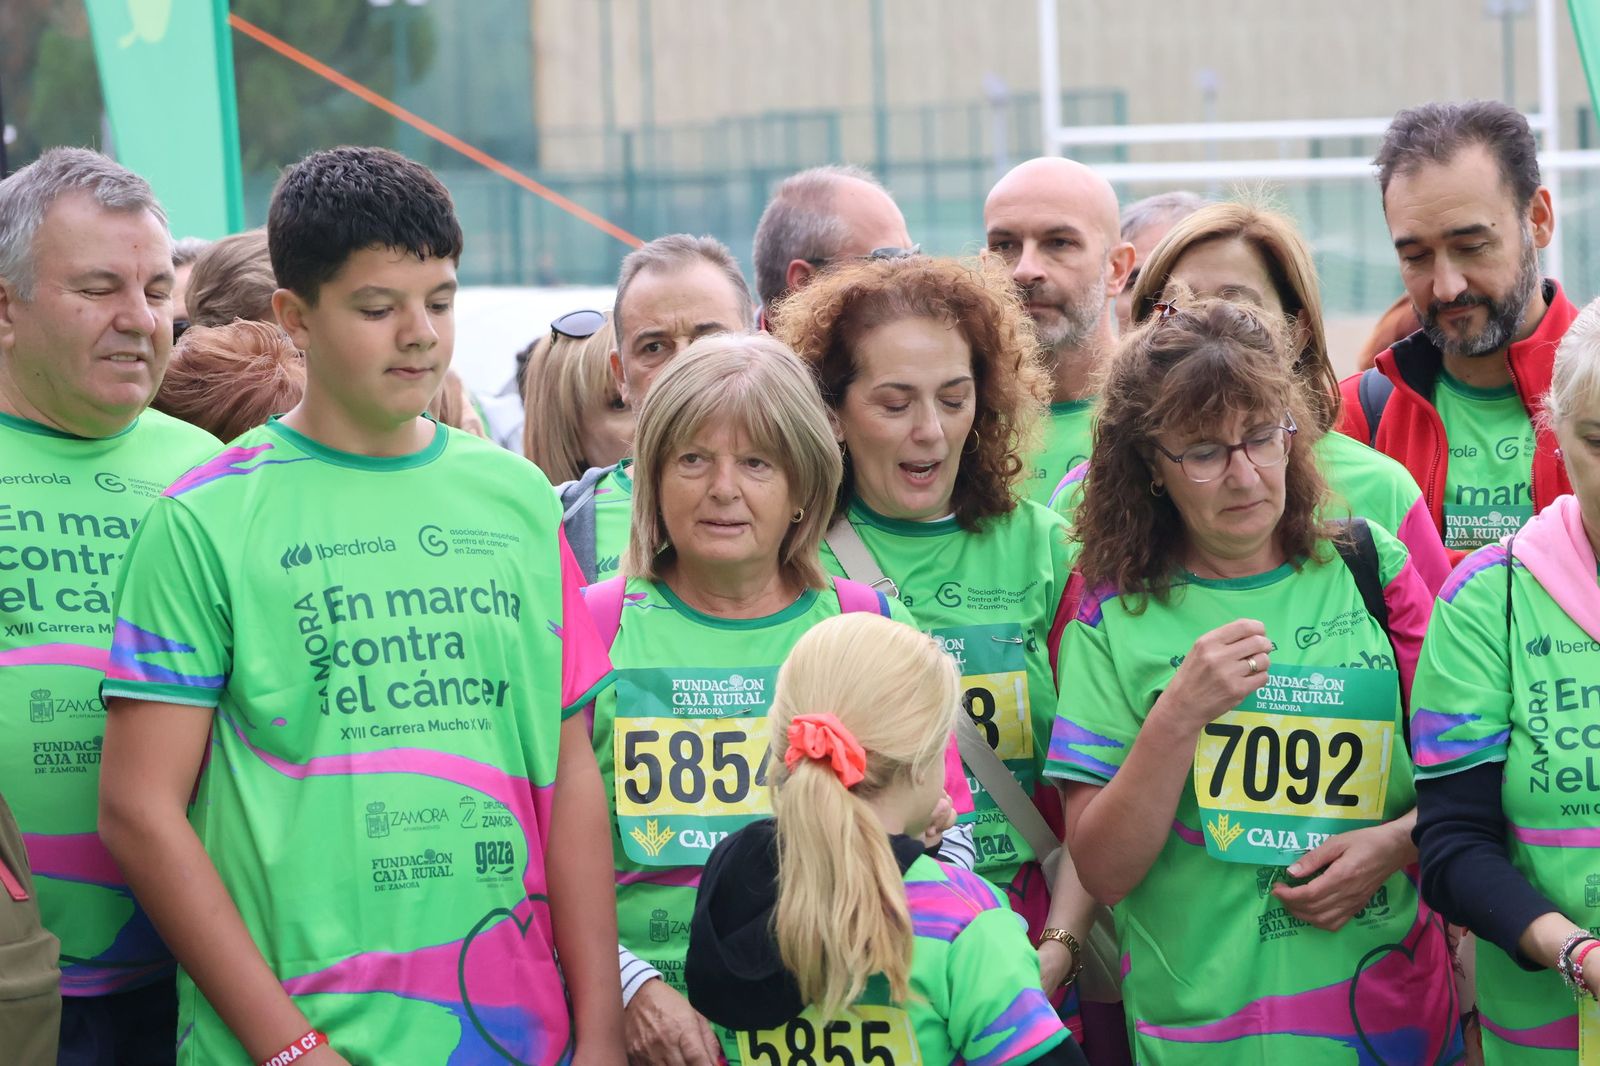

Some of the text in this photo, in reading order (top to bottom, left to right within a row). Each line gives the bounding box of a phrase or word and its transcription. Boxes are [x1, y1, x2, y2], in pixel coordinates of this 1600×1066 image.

[1446, 511, 1521, 527] UNDACION
[1446, 528, 1469, 540] AJA
[315, 536, 397, 561] Iberdrola
[0, 544, 124, 576] contr
[0, 577, 115, 614] el cá
[323, 578, 521, 625] En marcha
[978, 603, 1008, 611] Zamora
[5, 622, 34, 637] XVII
[38, 622, 95, 634] Carrera
[332, 625, 466, 669] contra
[335, 669, 509, 715] el cáncer
[672, 692, 765, 706] CAJA RURAL
[1256, 687, 1345, 705] CAJA RURAL
[673, 706, 724, 715] DE ZAMORA
[1256, 701, 1302, 712] DE ZAMORA
[340, 726, 367, 741] XVII
[370, 722, 425, 738] Carrera
[428, 718, 470, 733] Mucho
[1528, 680, 1550, 793] ZAMORA
[33, 753, 72, 766] CAJA
[1204, 722, 1364, 807] 7092
[34, 766, 87, 775] DE ZAMORA
[1555, 757, 1600, 793] el
[390, 807, 450, 827] ZAMORA
[1560, 803, 1590, 816] XVII
[481, 815, 513, 828] ZAMORA
[1246, 828, 1300, 849] CAJA
[475, 840, 515, 875] gaza
[372, 865, 454, 883] CAJA RURAL
[374, 881, 420, 892] DE ZAMORA
[650, 960, 685, 970] FUND
[300, 1031, 318, 1050] CF
